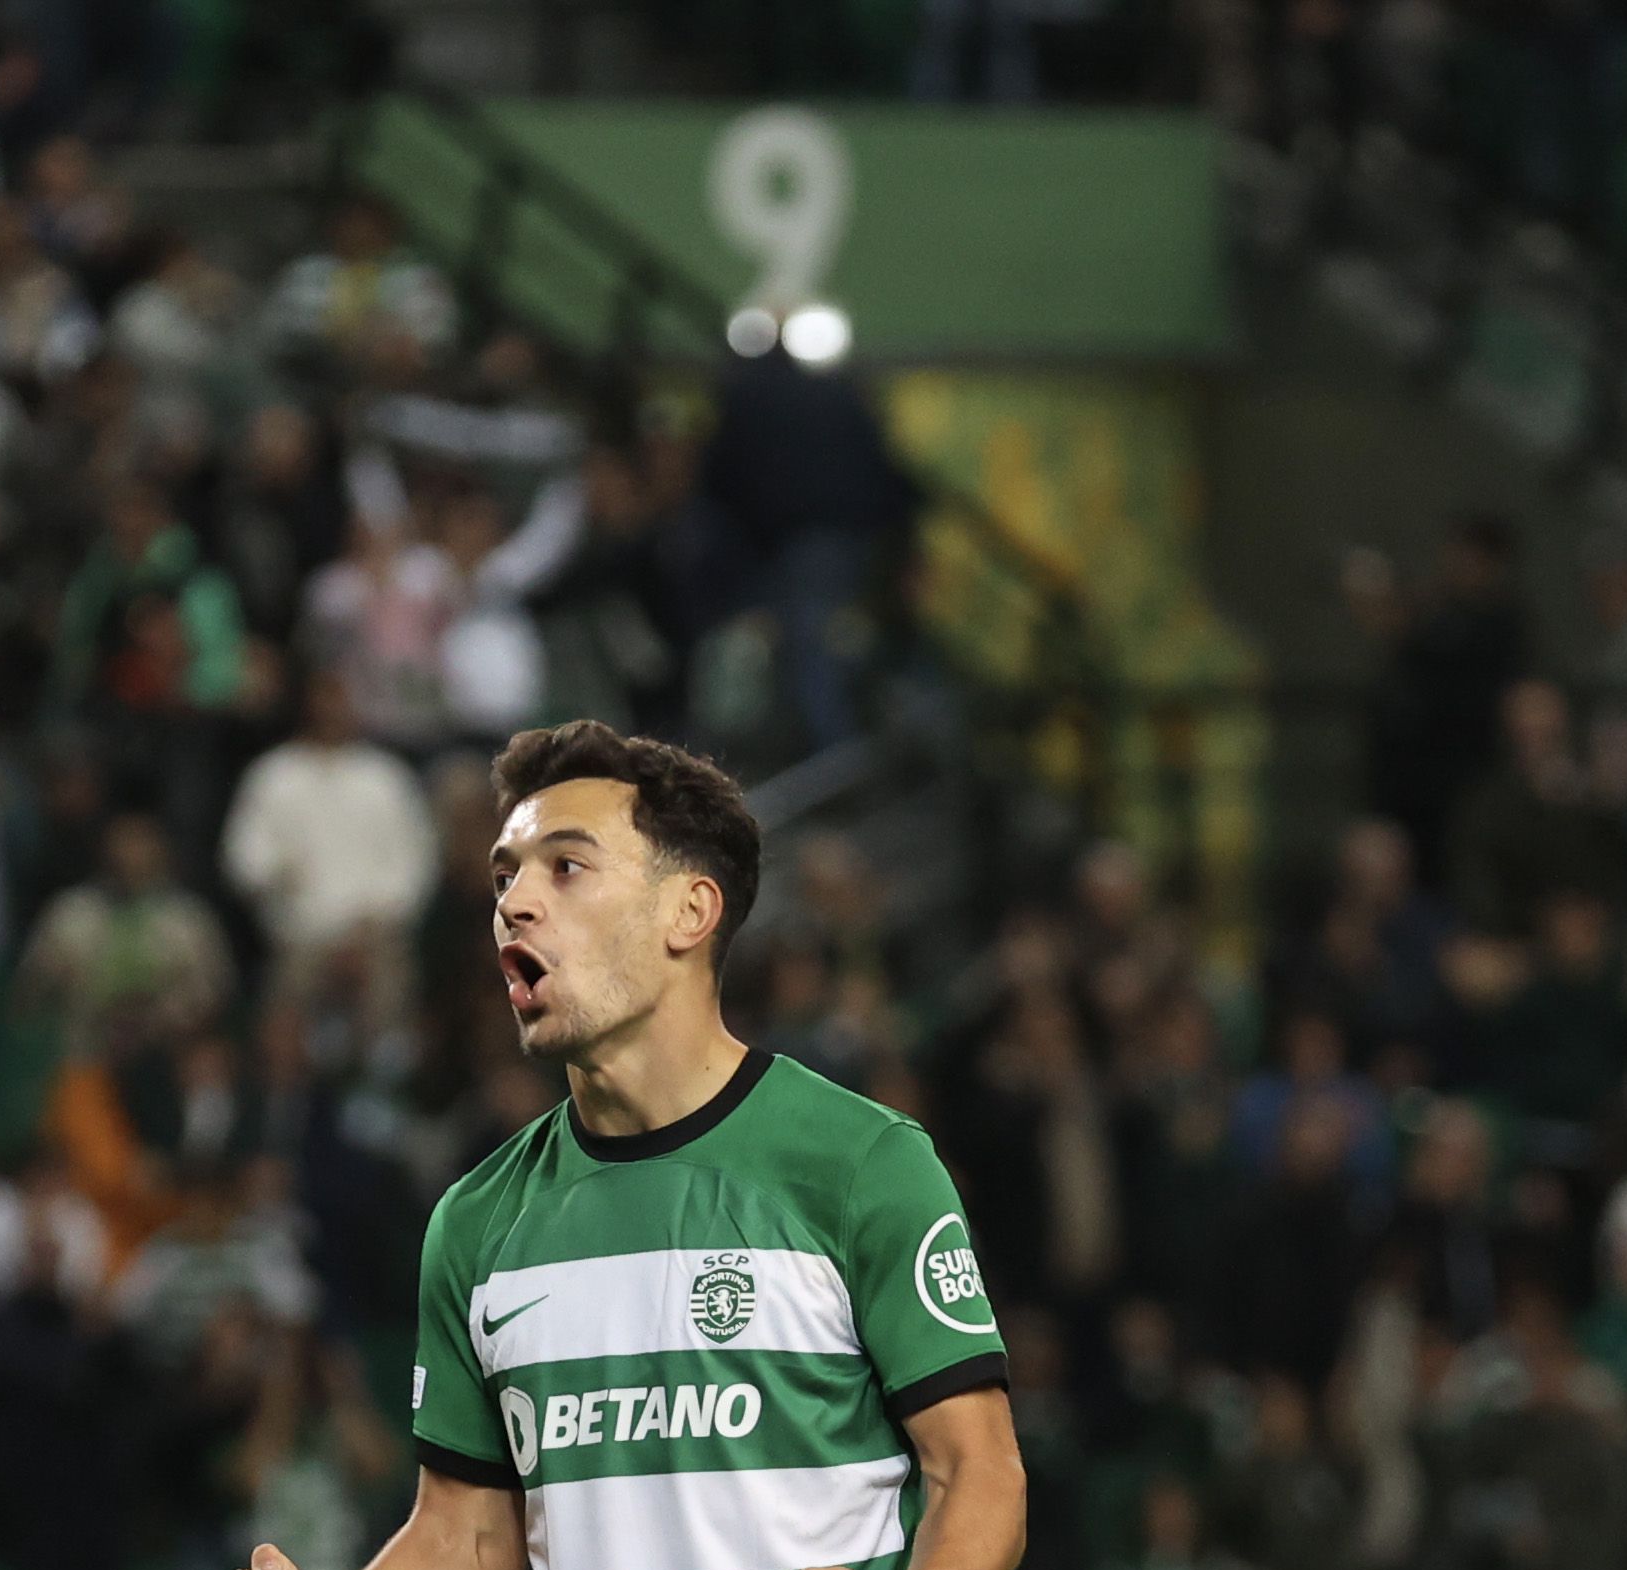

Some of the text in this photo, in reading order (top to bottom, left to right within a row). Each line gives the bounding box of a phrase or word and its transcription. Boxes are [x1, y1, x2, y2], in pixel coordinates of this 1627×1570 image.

[710, 104, 852, 312] 9
[702, 1253, 750, 1269] SCP
[696, 1271, 751, 1292] SPORTING
[697, 1320, 747, 1336] PORTUGAL
[541, 1383, 762, 1450] BETANO
